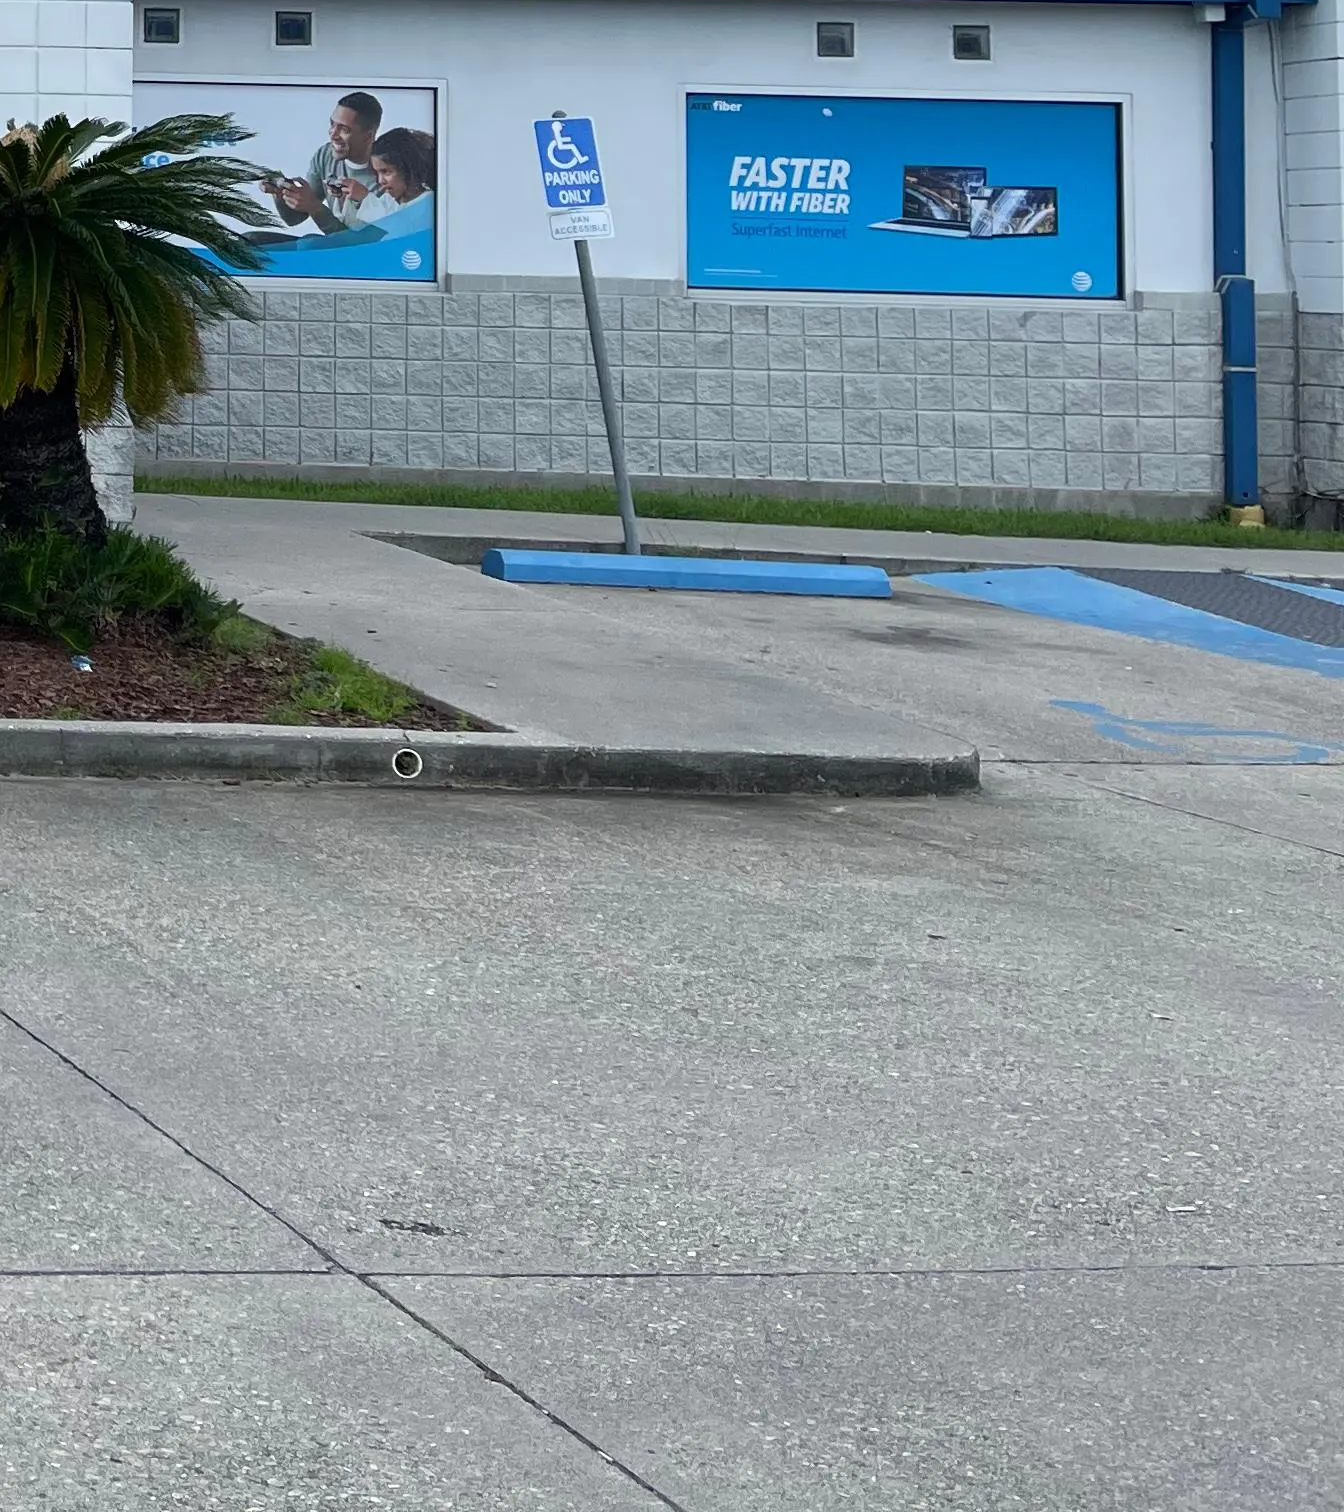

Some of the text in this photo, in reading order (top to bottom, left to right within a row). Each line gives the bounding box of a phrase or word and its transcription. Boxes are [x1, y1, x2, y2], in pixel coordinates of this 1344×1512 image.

[544, 169, 600, 187] PARKING
[729, 156, 851, 191] FASTER
[558, 188, 592, 205] ONLY
[730, 190, 851, 215] WITH FIBER
[570, 215, 590, 225] VAN
[554, 223, 608, 236] ACCESSIBLE
[731, 222, 848, 240] Superfast Internet
